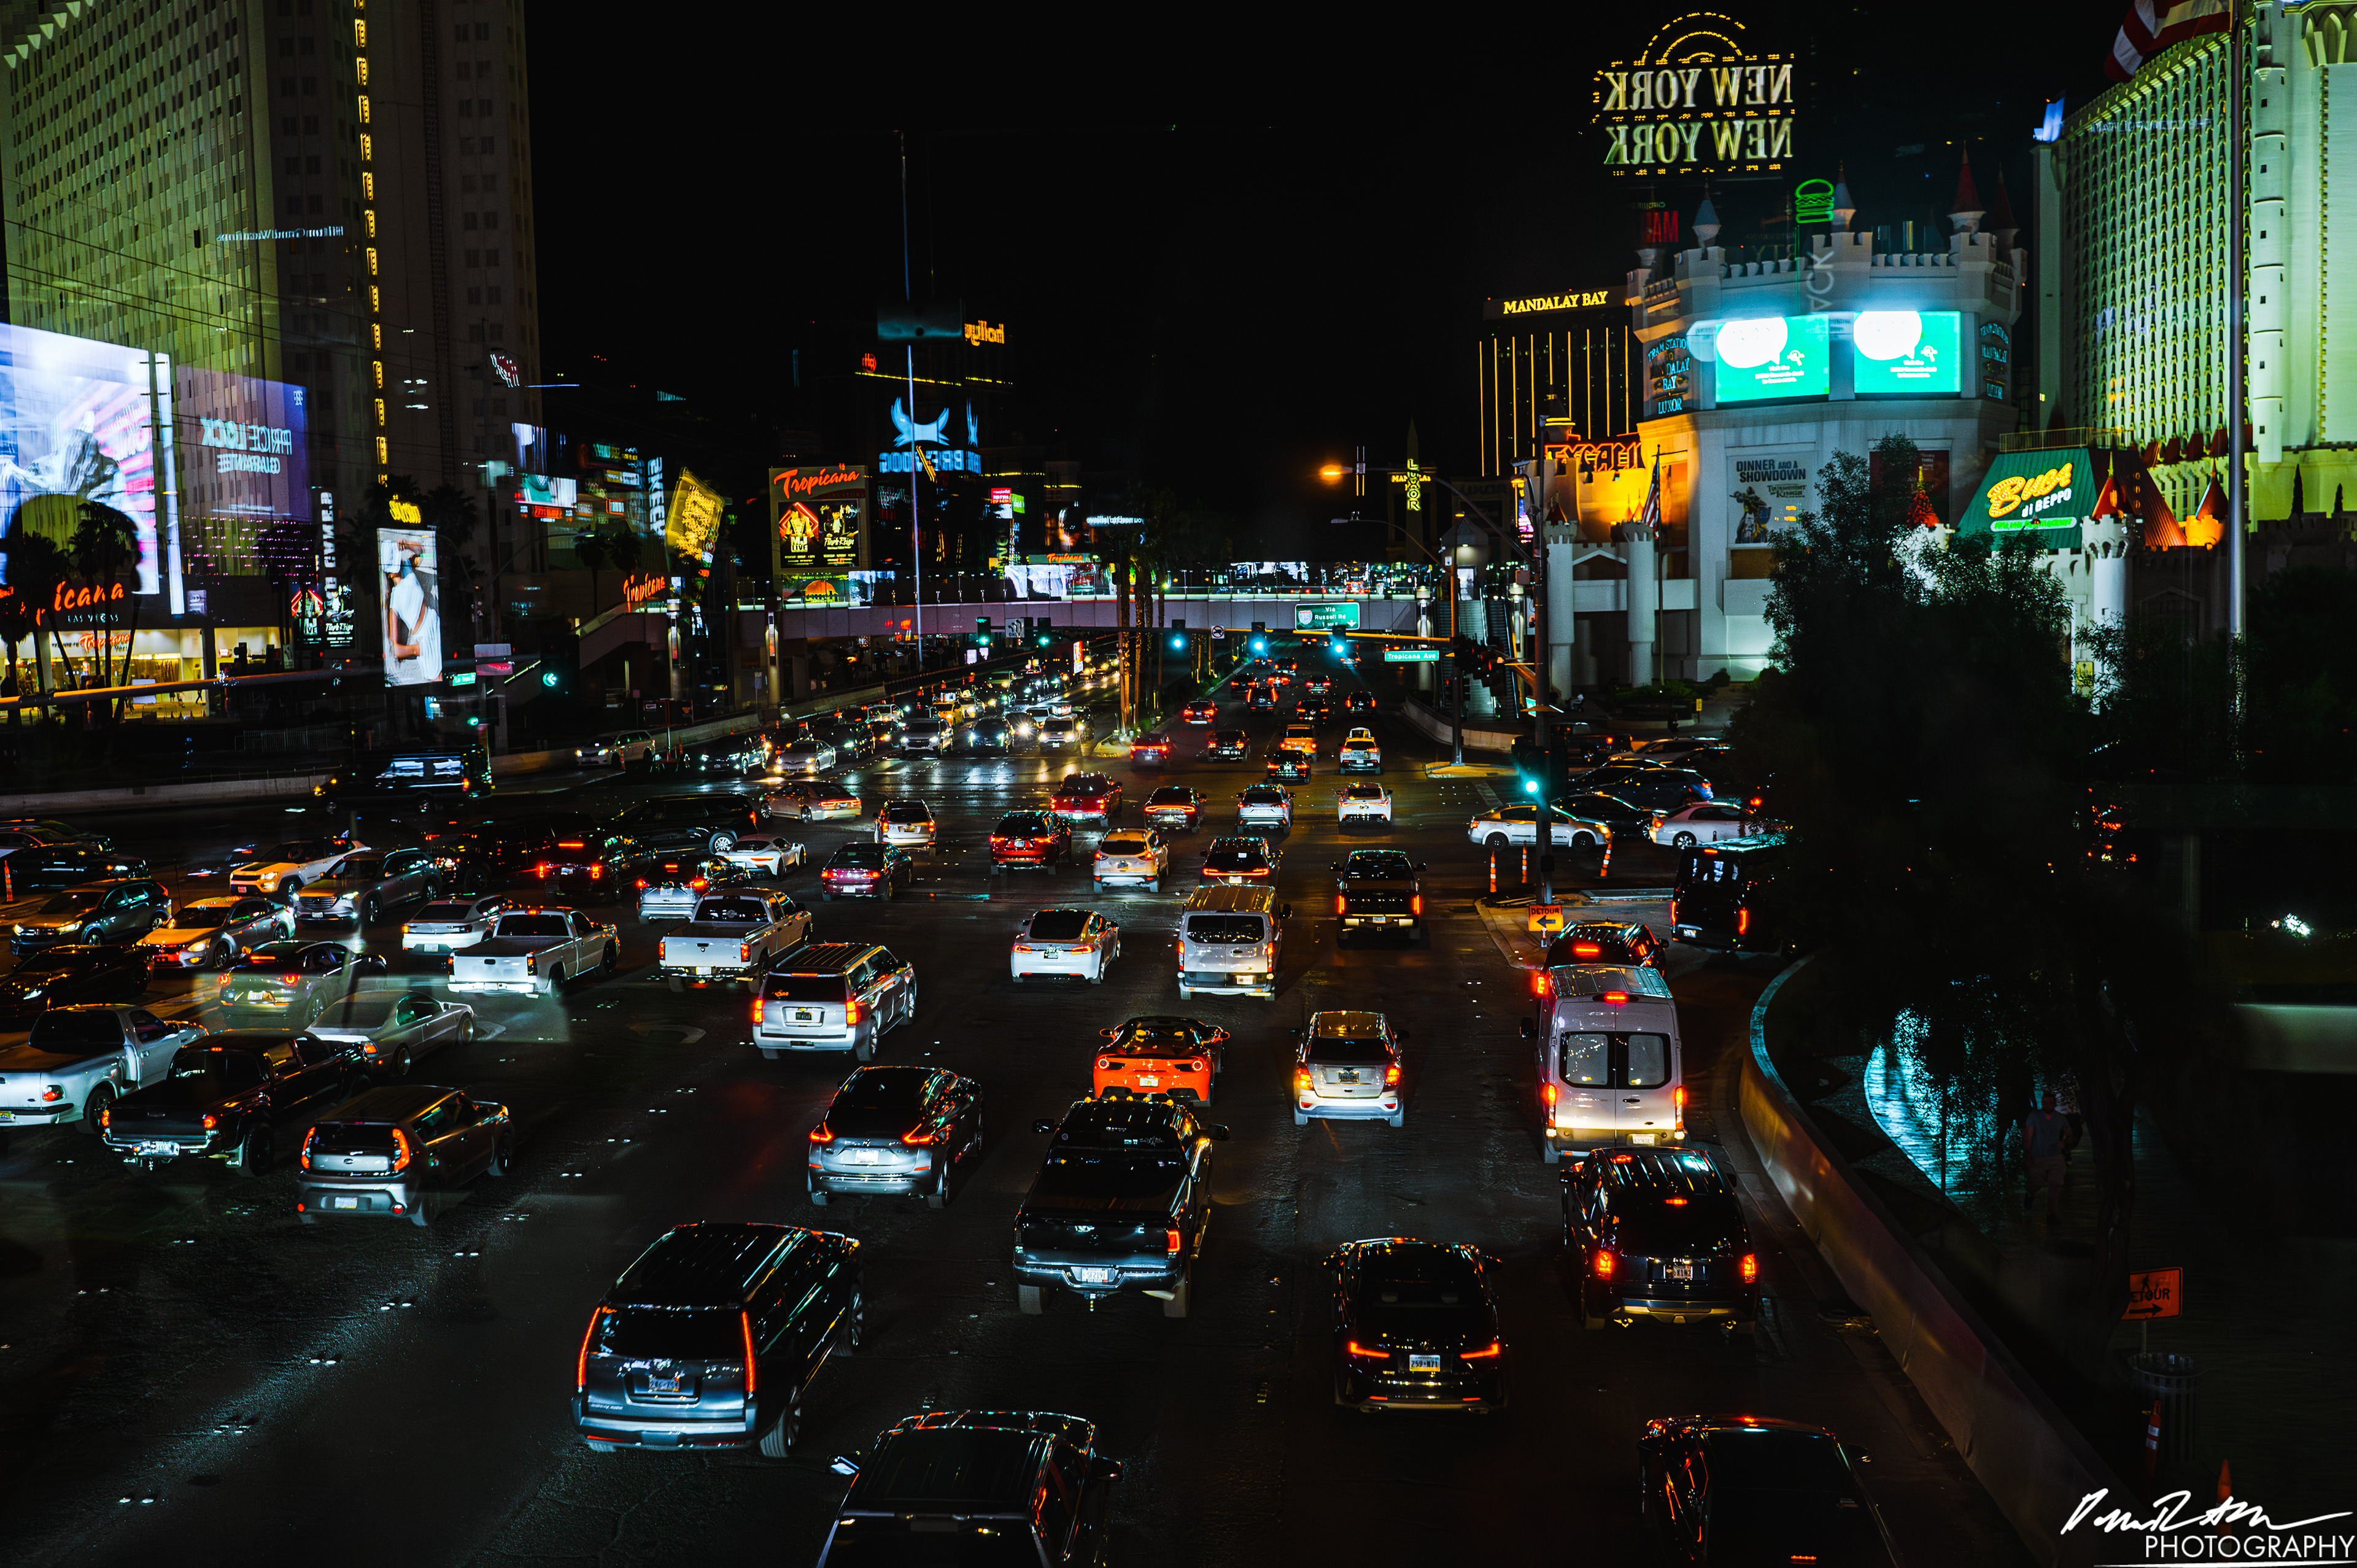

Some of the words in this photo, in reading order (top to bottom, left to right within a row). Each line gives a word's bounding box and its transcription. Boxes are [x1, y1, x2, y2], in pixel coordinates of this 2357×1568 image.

[1503, 295, 1579, 314] MANDALAY
[1582, 291, 1608, 306] BAY
[1647, 342, 1665, 362] TRAM
[1666, 338, 1688, 350] STATIO
[1663, 375, 1677, 391] BAY
[1658, 398, 1682, 414] LUXOR
[1736, 460, 1775, 472] DINNER
[774, 468, 859, 499] Tropicana
[1740, 468, 1806, 483] SHOWDOWN
[2022, 503, 2034, 517] di
[2035, 488, 2072, 512] BEPPO
[791, 536, 808, 546] MJ
[1047, 553, 1083, 563] Tropicana
[2131, 1288, 2170, 1302] ETOUR
